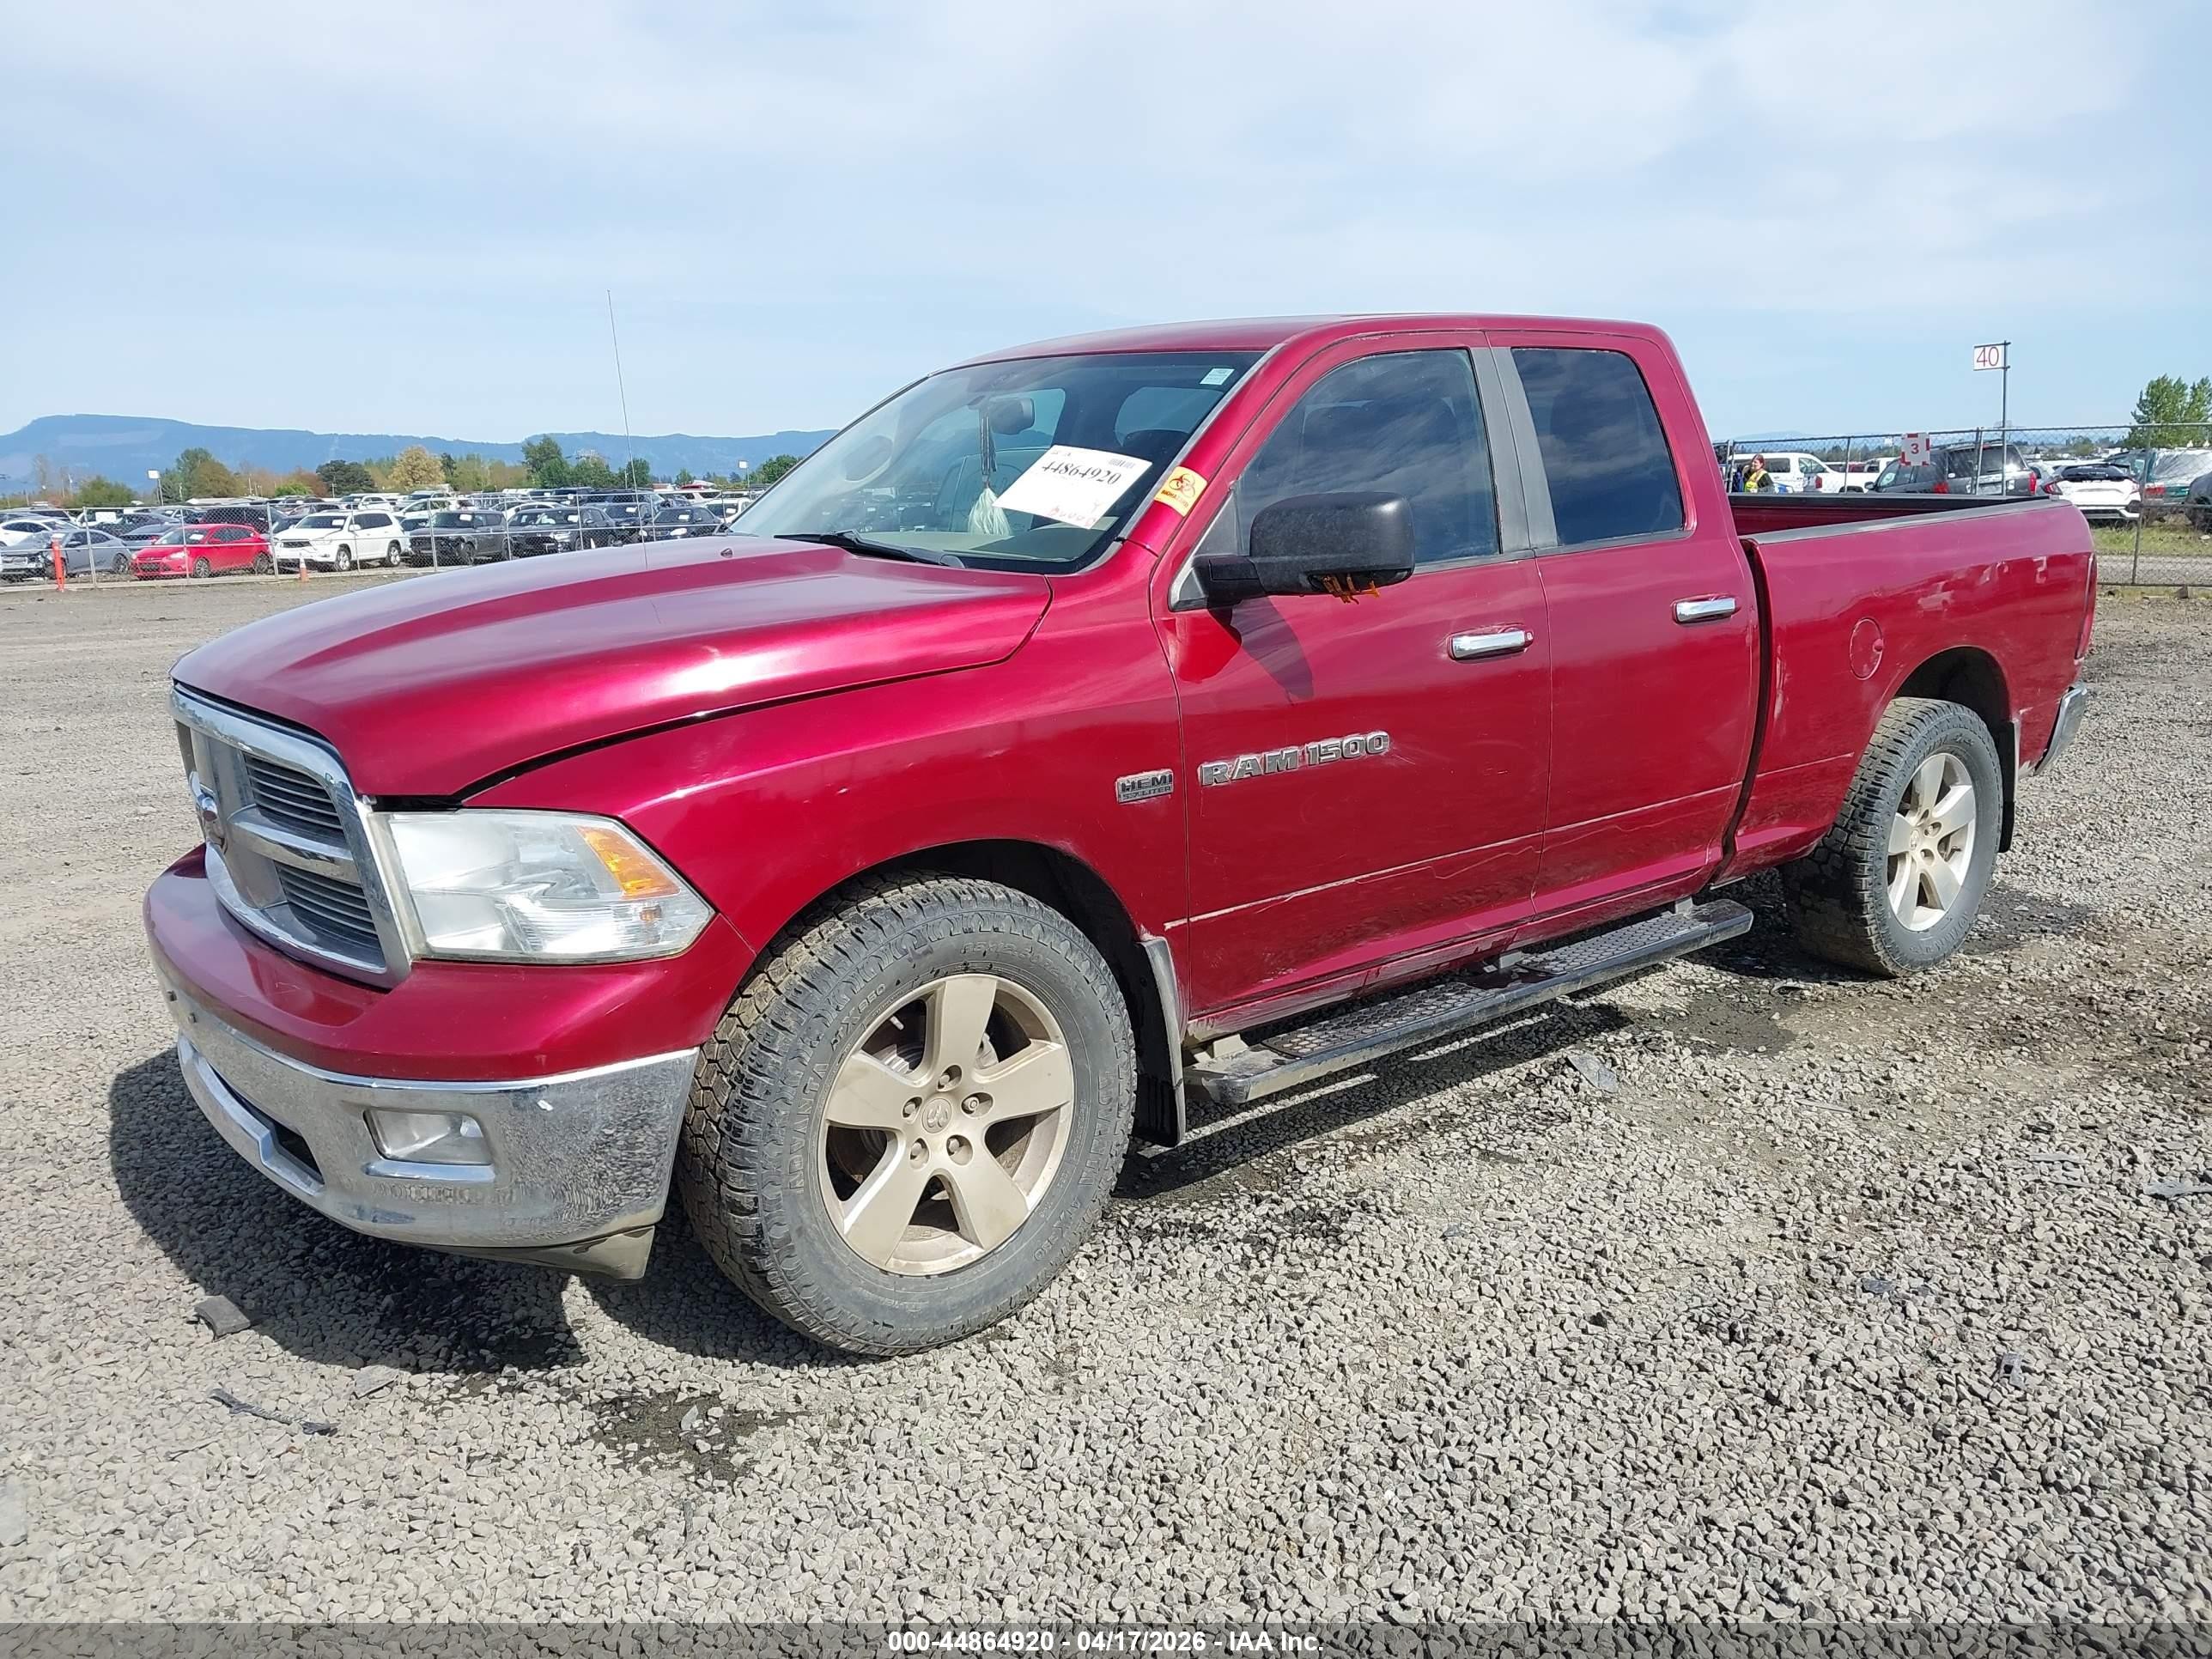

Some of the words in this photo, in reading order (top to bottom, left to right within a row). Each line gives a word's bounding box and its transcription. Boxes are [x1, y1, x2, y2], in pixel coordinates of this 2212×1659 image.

[1976, 346, 1999, 367] 40
[1911, 443, 1919, 454] 3
[1042, 461, 1121, 485] 44864920
[1200, 749, 1300, 787] RAM
[1306, 731, 1390, 765] 1500
[1121, 774, 1173, 793] HEMI
[1141, 786, 1171, 796] LITER
